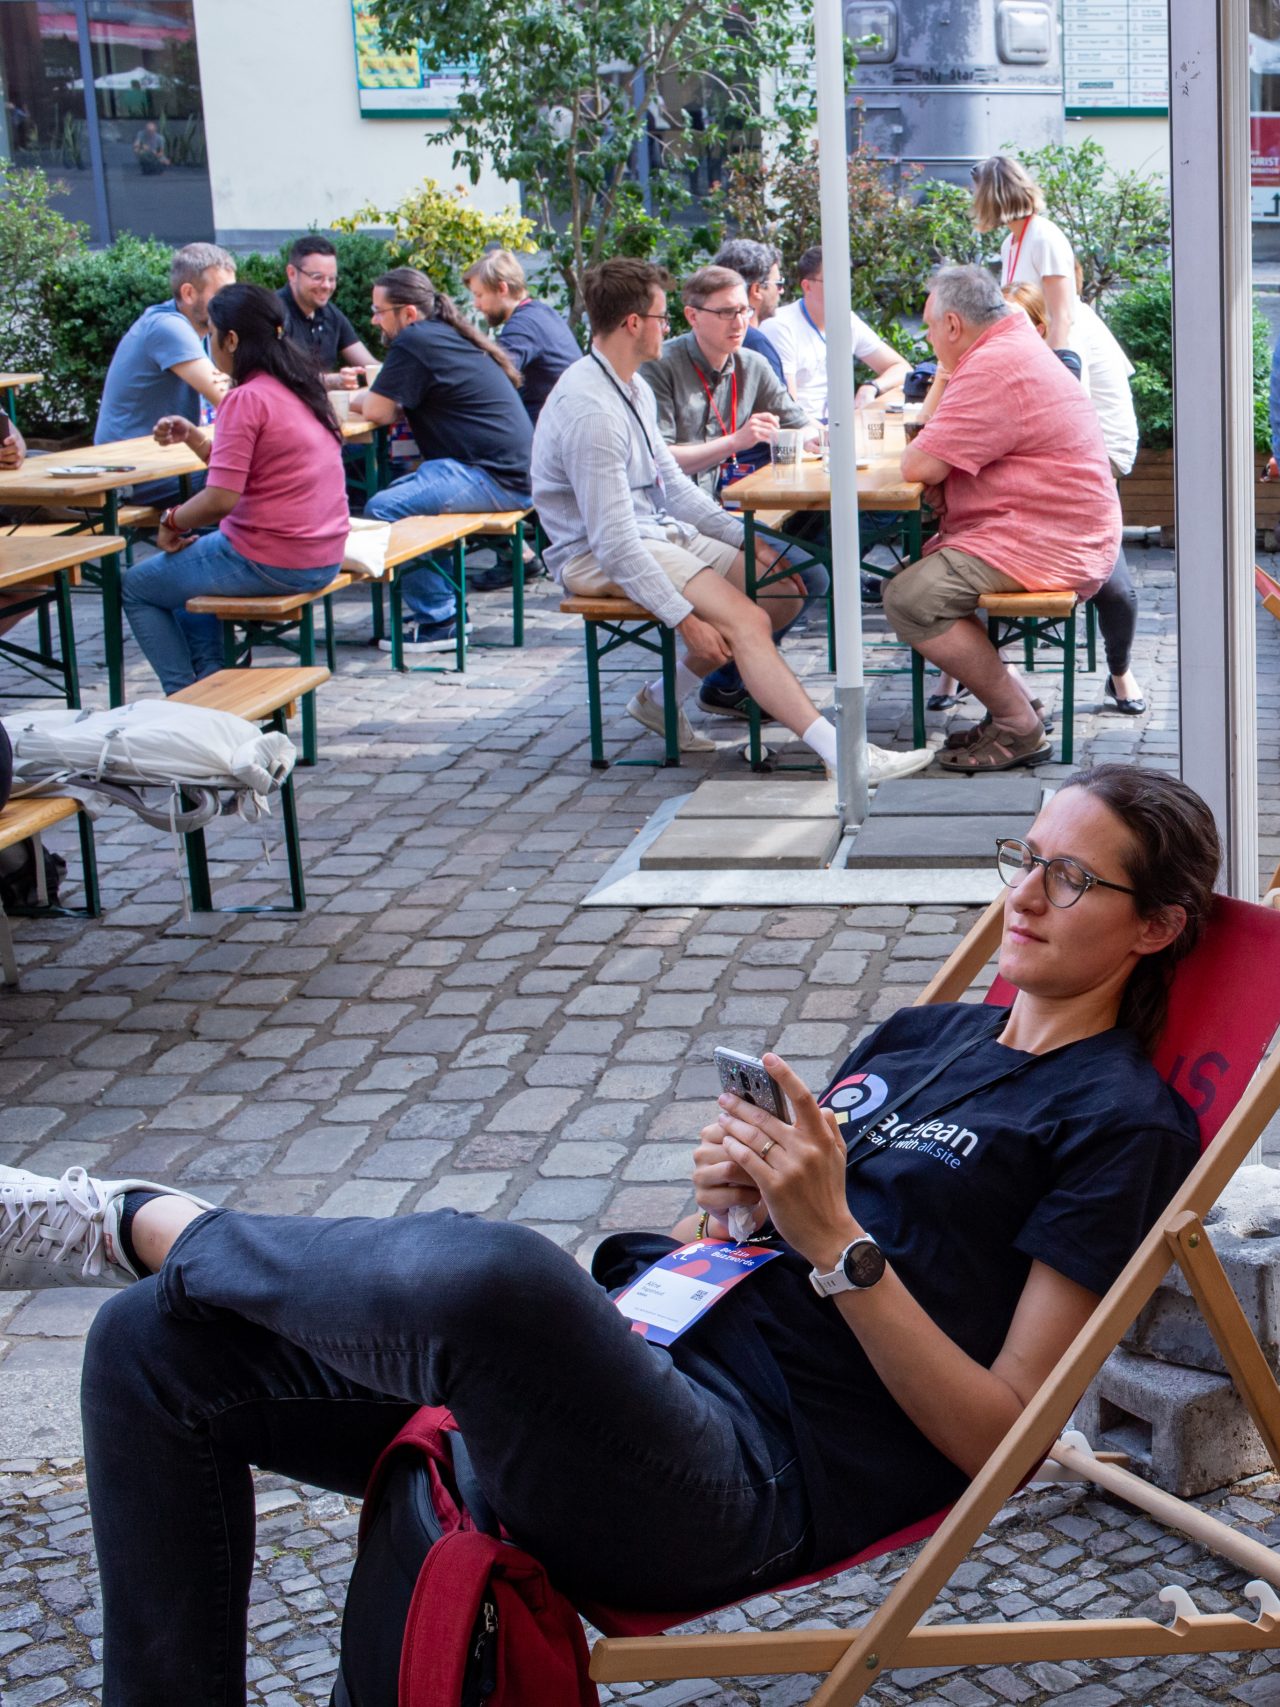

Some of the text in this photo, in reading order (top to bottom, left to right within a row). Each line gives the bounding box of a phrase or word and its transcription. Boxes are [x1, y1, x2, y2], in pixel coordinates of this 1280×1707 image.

[917, 1141, 961, 1169] all.site
[710, 1251, 755, 1267] Buzzwords
[719, 1246, 751, 1258] Berlin
